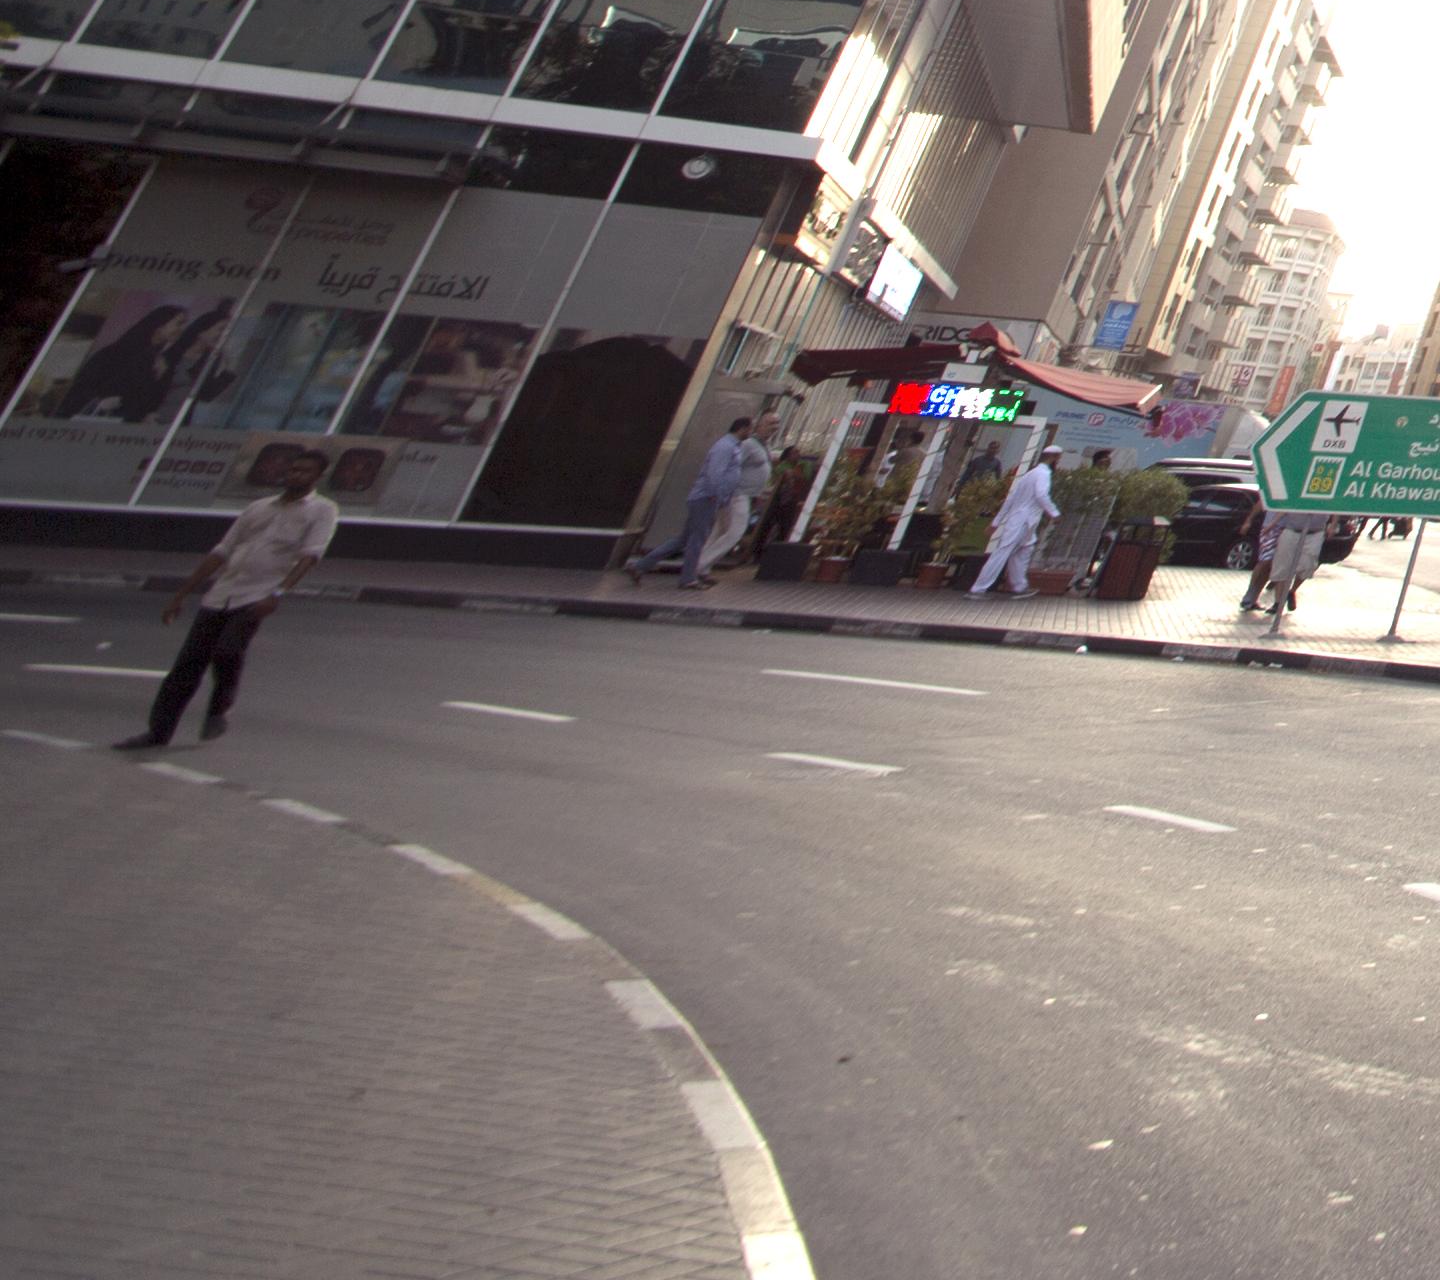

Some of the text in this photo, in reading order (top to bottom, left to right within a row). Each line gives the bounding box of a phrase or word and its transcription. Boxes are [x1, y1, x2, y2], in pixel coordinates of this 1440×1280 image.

[90, 250, 282, 283] pening Soon
[1323, 440, 1346, 450] DXB
[1350, 461, 1371, 478] Al
[1309, 477, 1333, 492] 89
[1344, 481, 1368, 498] Al
